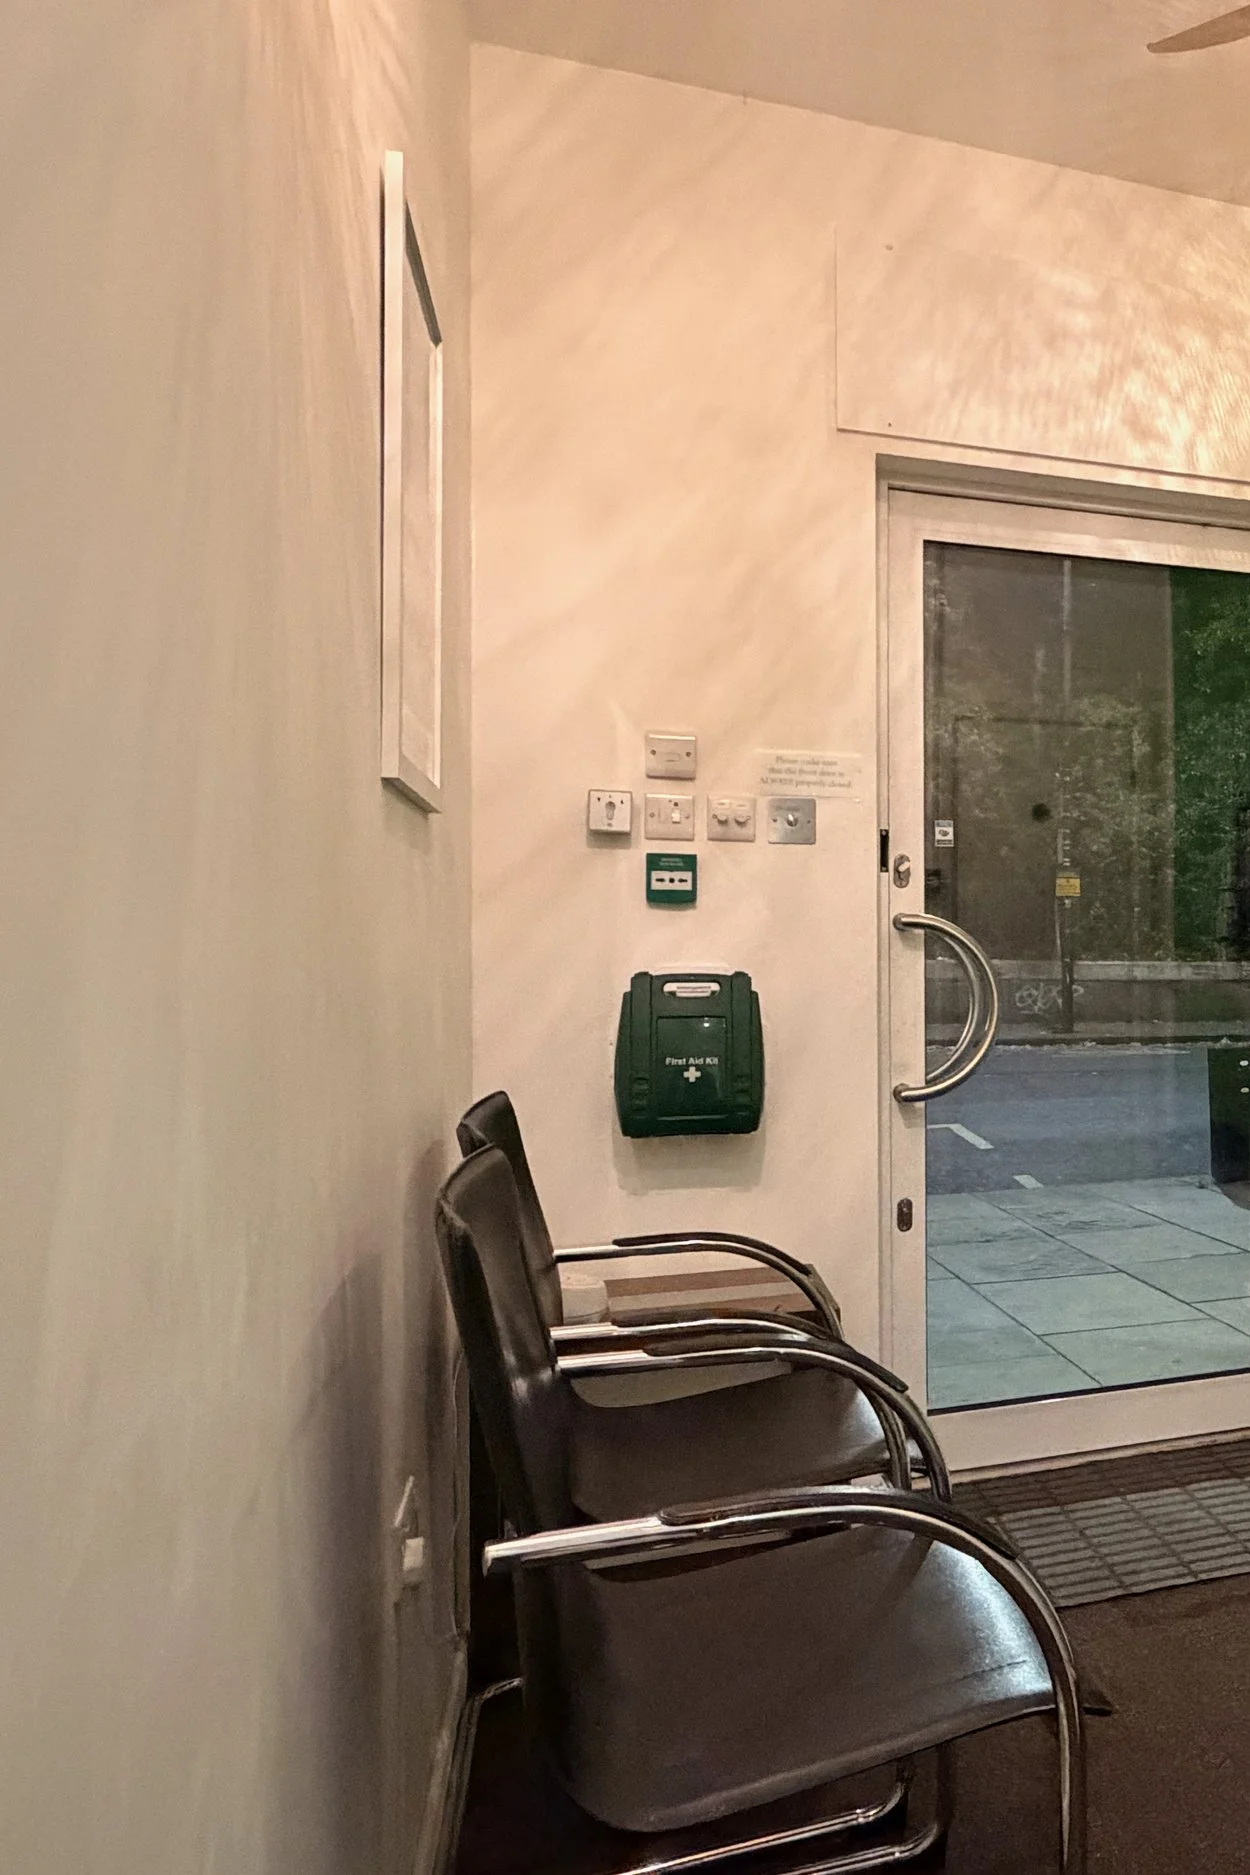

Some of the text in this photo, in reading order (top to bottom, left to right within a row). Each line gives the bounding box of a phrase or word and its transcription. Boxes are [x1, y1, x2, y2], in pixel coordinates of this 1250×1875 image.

[665, 1056, 719, 1066] First Aid Kit
